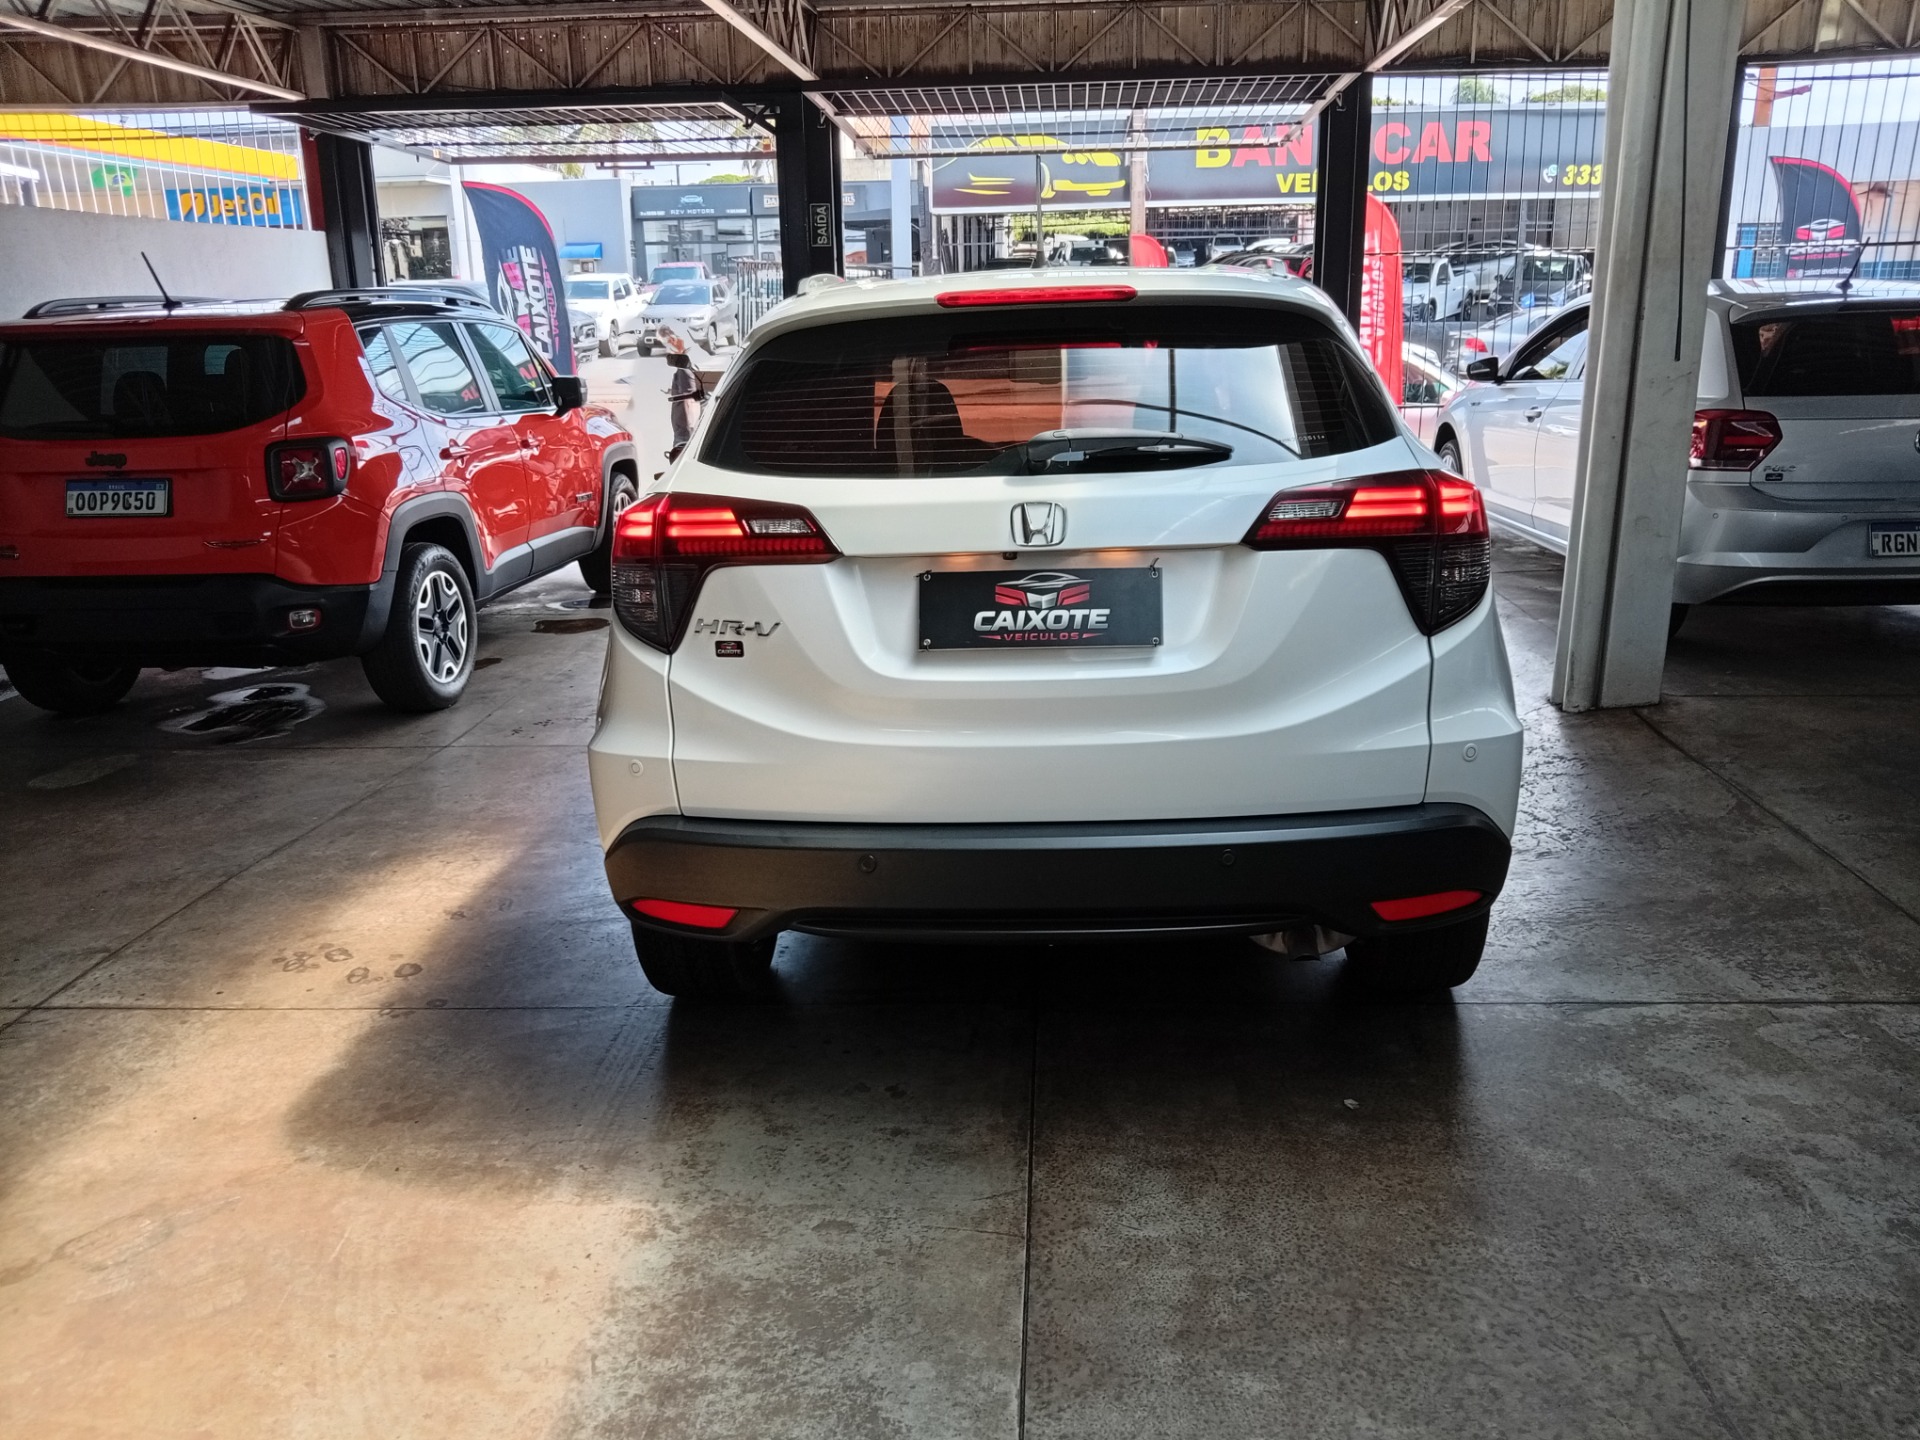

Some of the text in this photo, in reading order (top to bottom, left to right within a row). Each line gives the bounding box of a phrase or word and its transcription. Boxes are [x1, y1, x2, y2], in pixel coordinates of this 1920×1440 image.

[1374, 120, 1493, 163] CAR
[210, 191, 280, 217] Jet Oil
[814, 206, 828, 244] SAÍDA
[519, 245, 553, 360] CAIXOTE
[694, 618, 783, 636] HR-V
[973, 608, 1111, 631] CAIXOTE
[1003, 631, 1080, 641] VEÍCULOS
